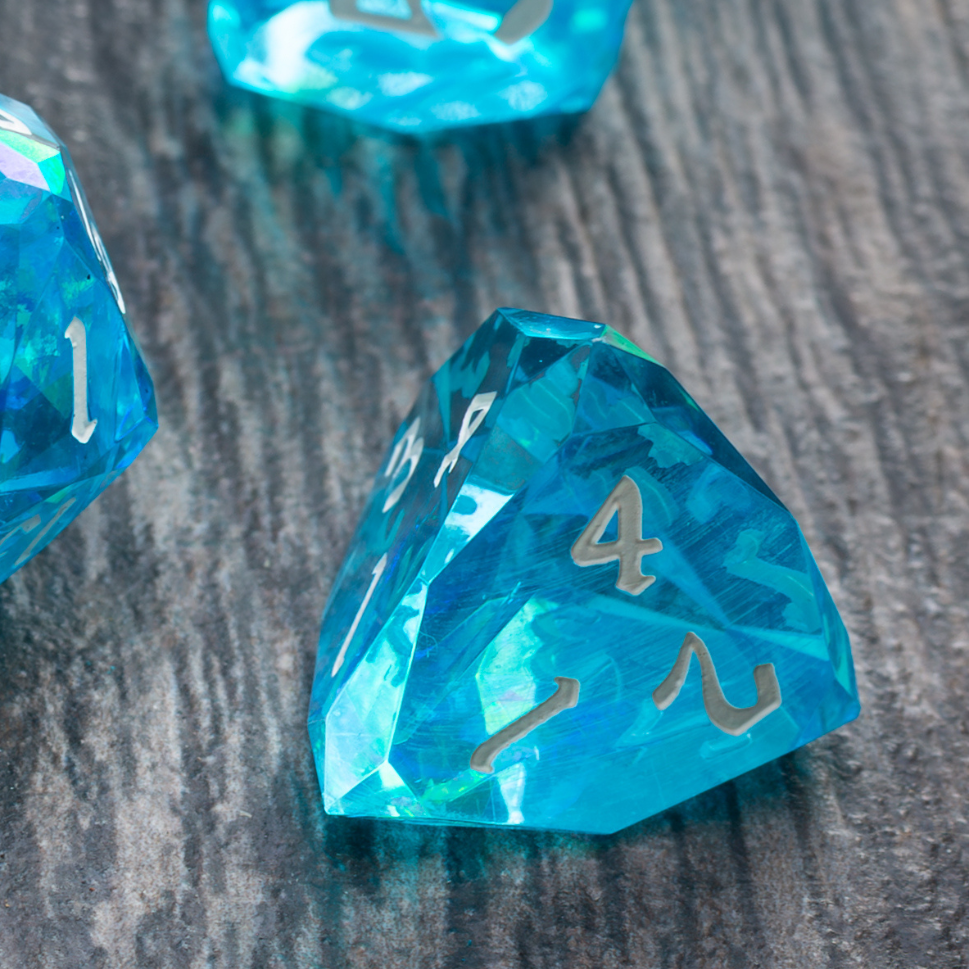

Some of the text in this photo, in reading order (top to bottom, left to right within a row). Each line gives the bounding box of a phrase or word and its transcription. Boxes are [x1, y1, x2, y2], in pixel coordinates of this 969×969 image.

[64, 317, 99, 444] 1
[571, 475, 663, 597] 4
[469, 675, 581, 774] 1
[652, 631, 782, 737] 2
